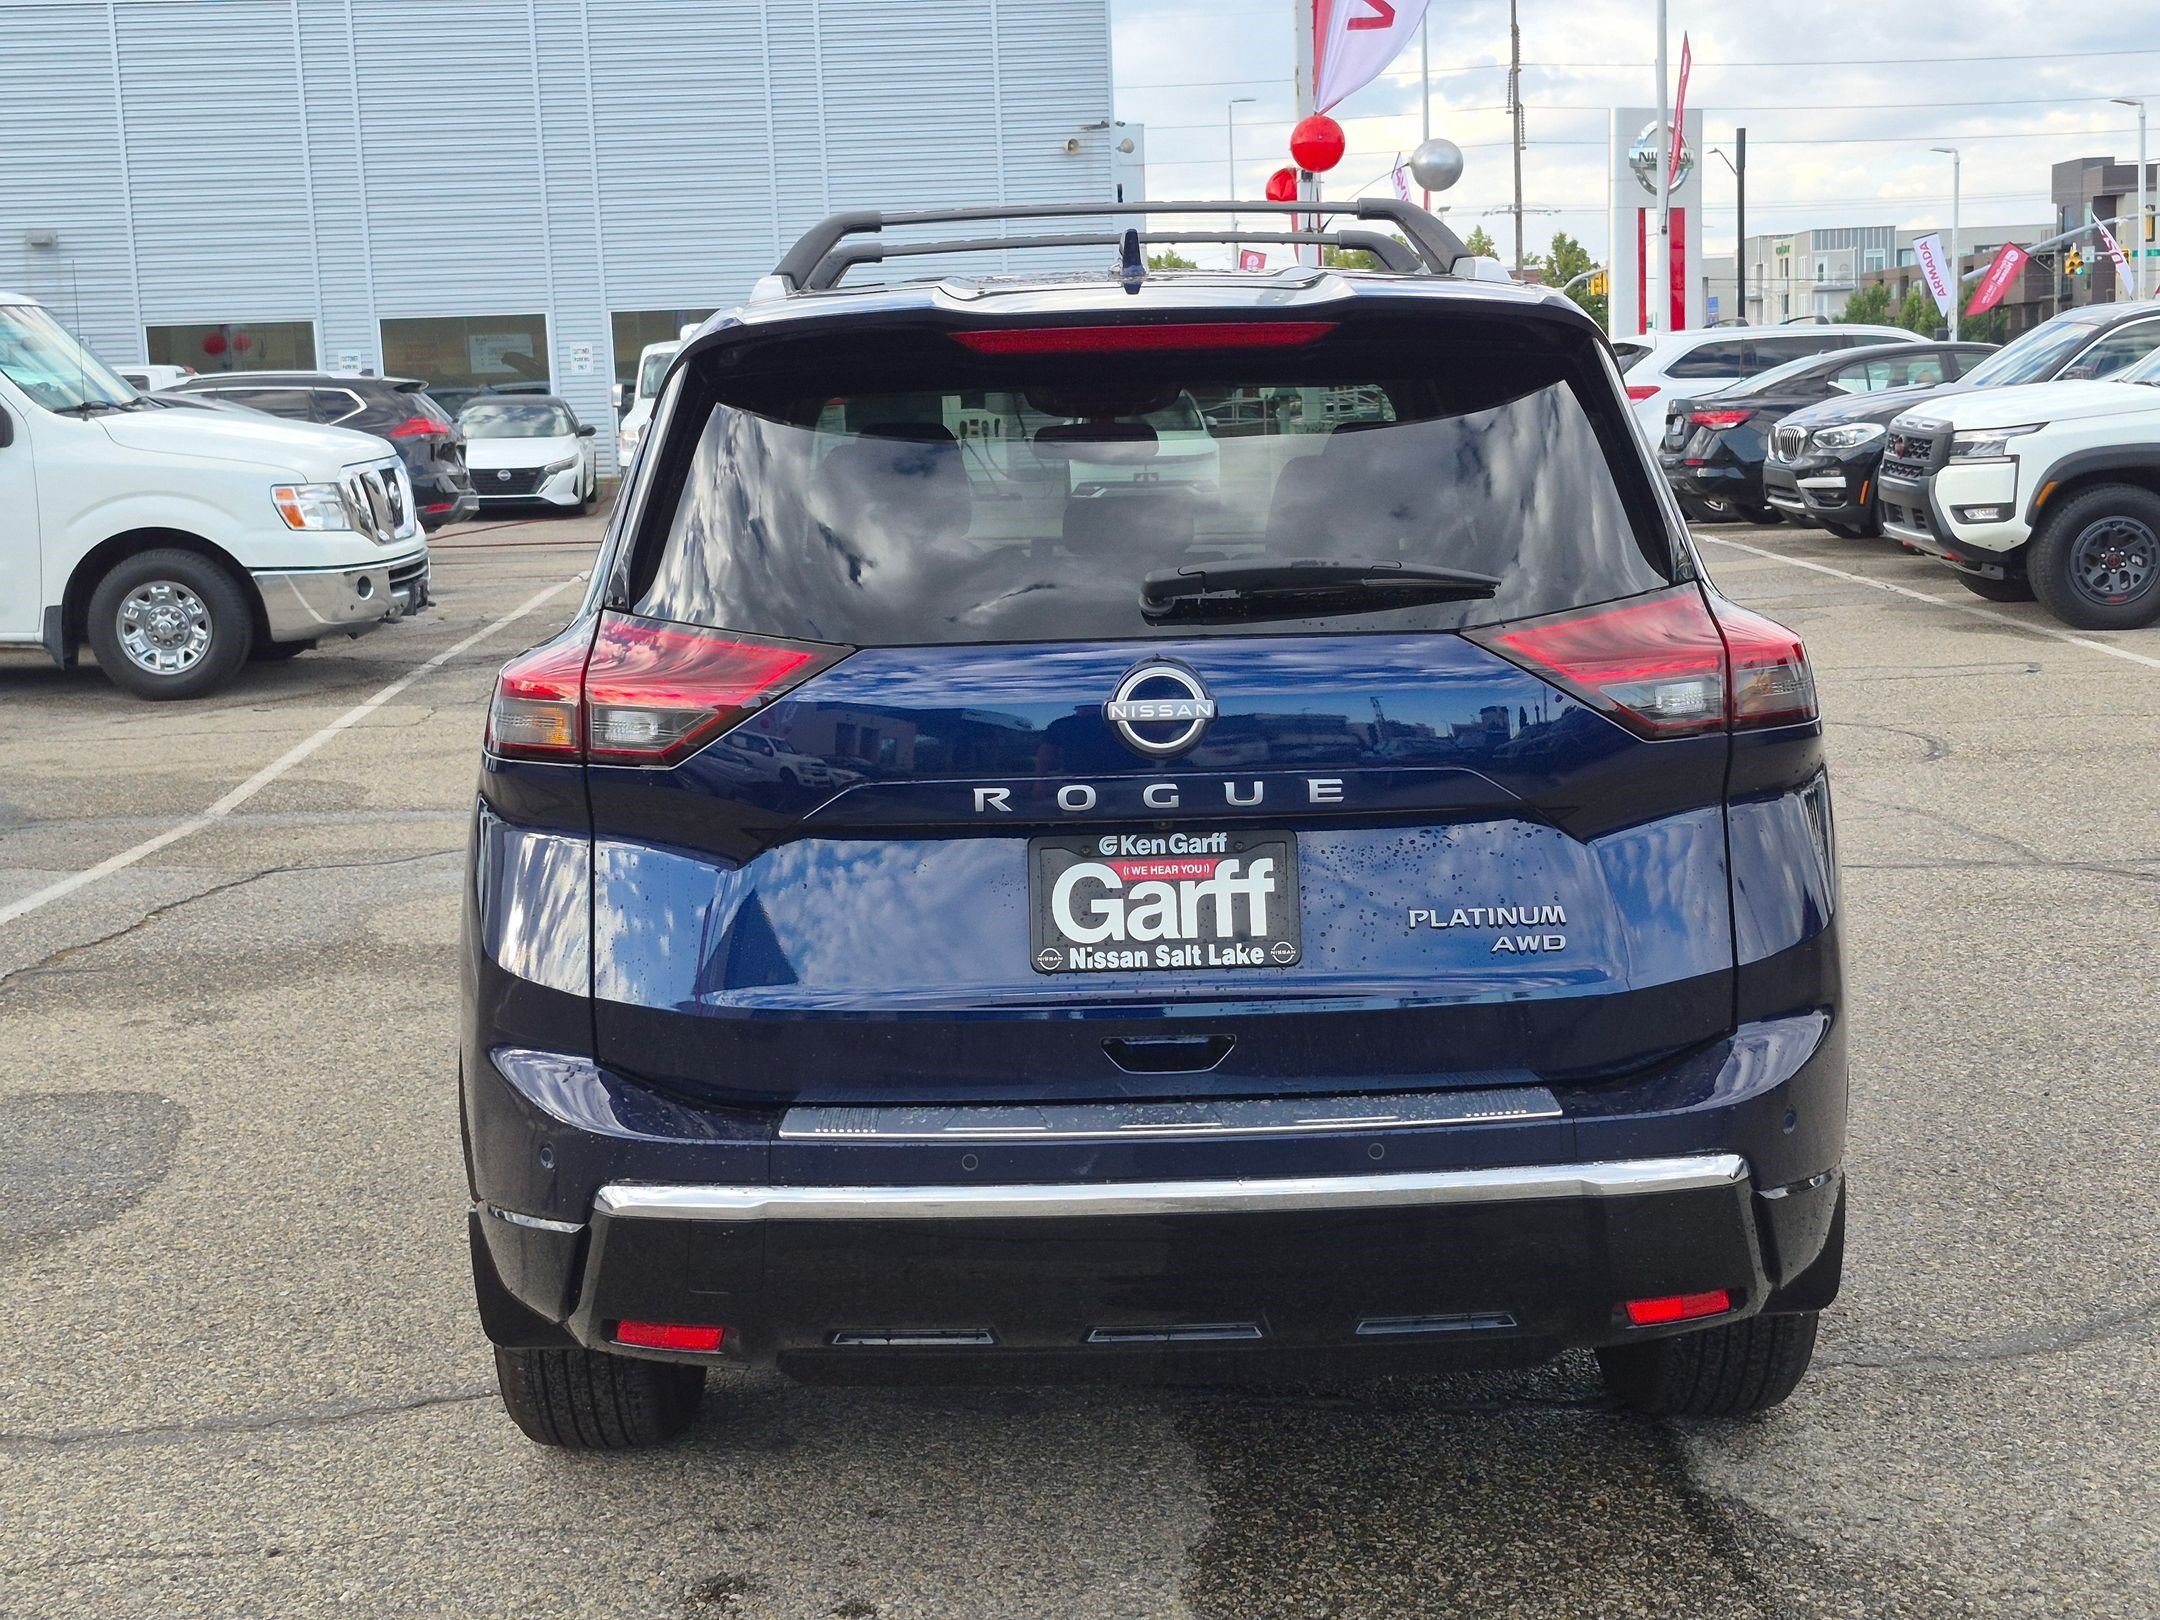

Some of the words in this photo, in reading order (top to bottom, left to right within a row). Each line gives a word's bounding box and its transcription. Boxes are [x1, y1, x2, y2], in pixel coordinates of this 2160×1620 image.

[1919, 241, 1947, 297] ARMADA
[1110, 702, 1214, 721] NISSAN
[973, 778, 1344, 812] ROGUE
[1120, 833, 1166, 855] Ken
[1169, 832, 1227, 854] Garff
[1131, 866, 1149, 876] WE
[1150, 865, 1179, 875] HEAR
[1181, 864, 1203, 875] YOU
[1051, 857, 1275, 944] Garff
[1408, 905, 1567, 928] PLATINUM
[1491, 934, 1567, 952] AWD
[1069, 946, 1149, 969] Nissan
[1155, 944, 1201, 967] Salt
[1208, 943, 1265, 966] Lake
